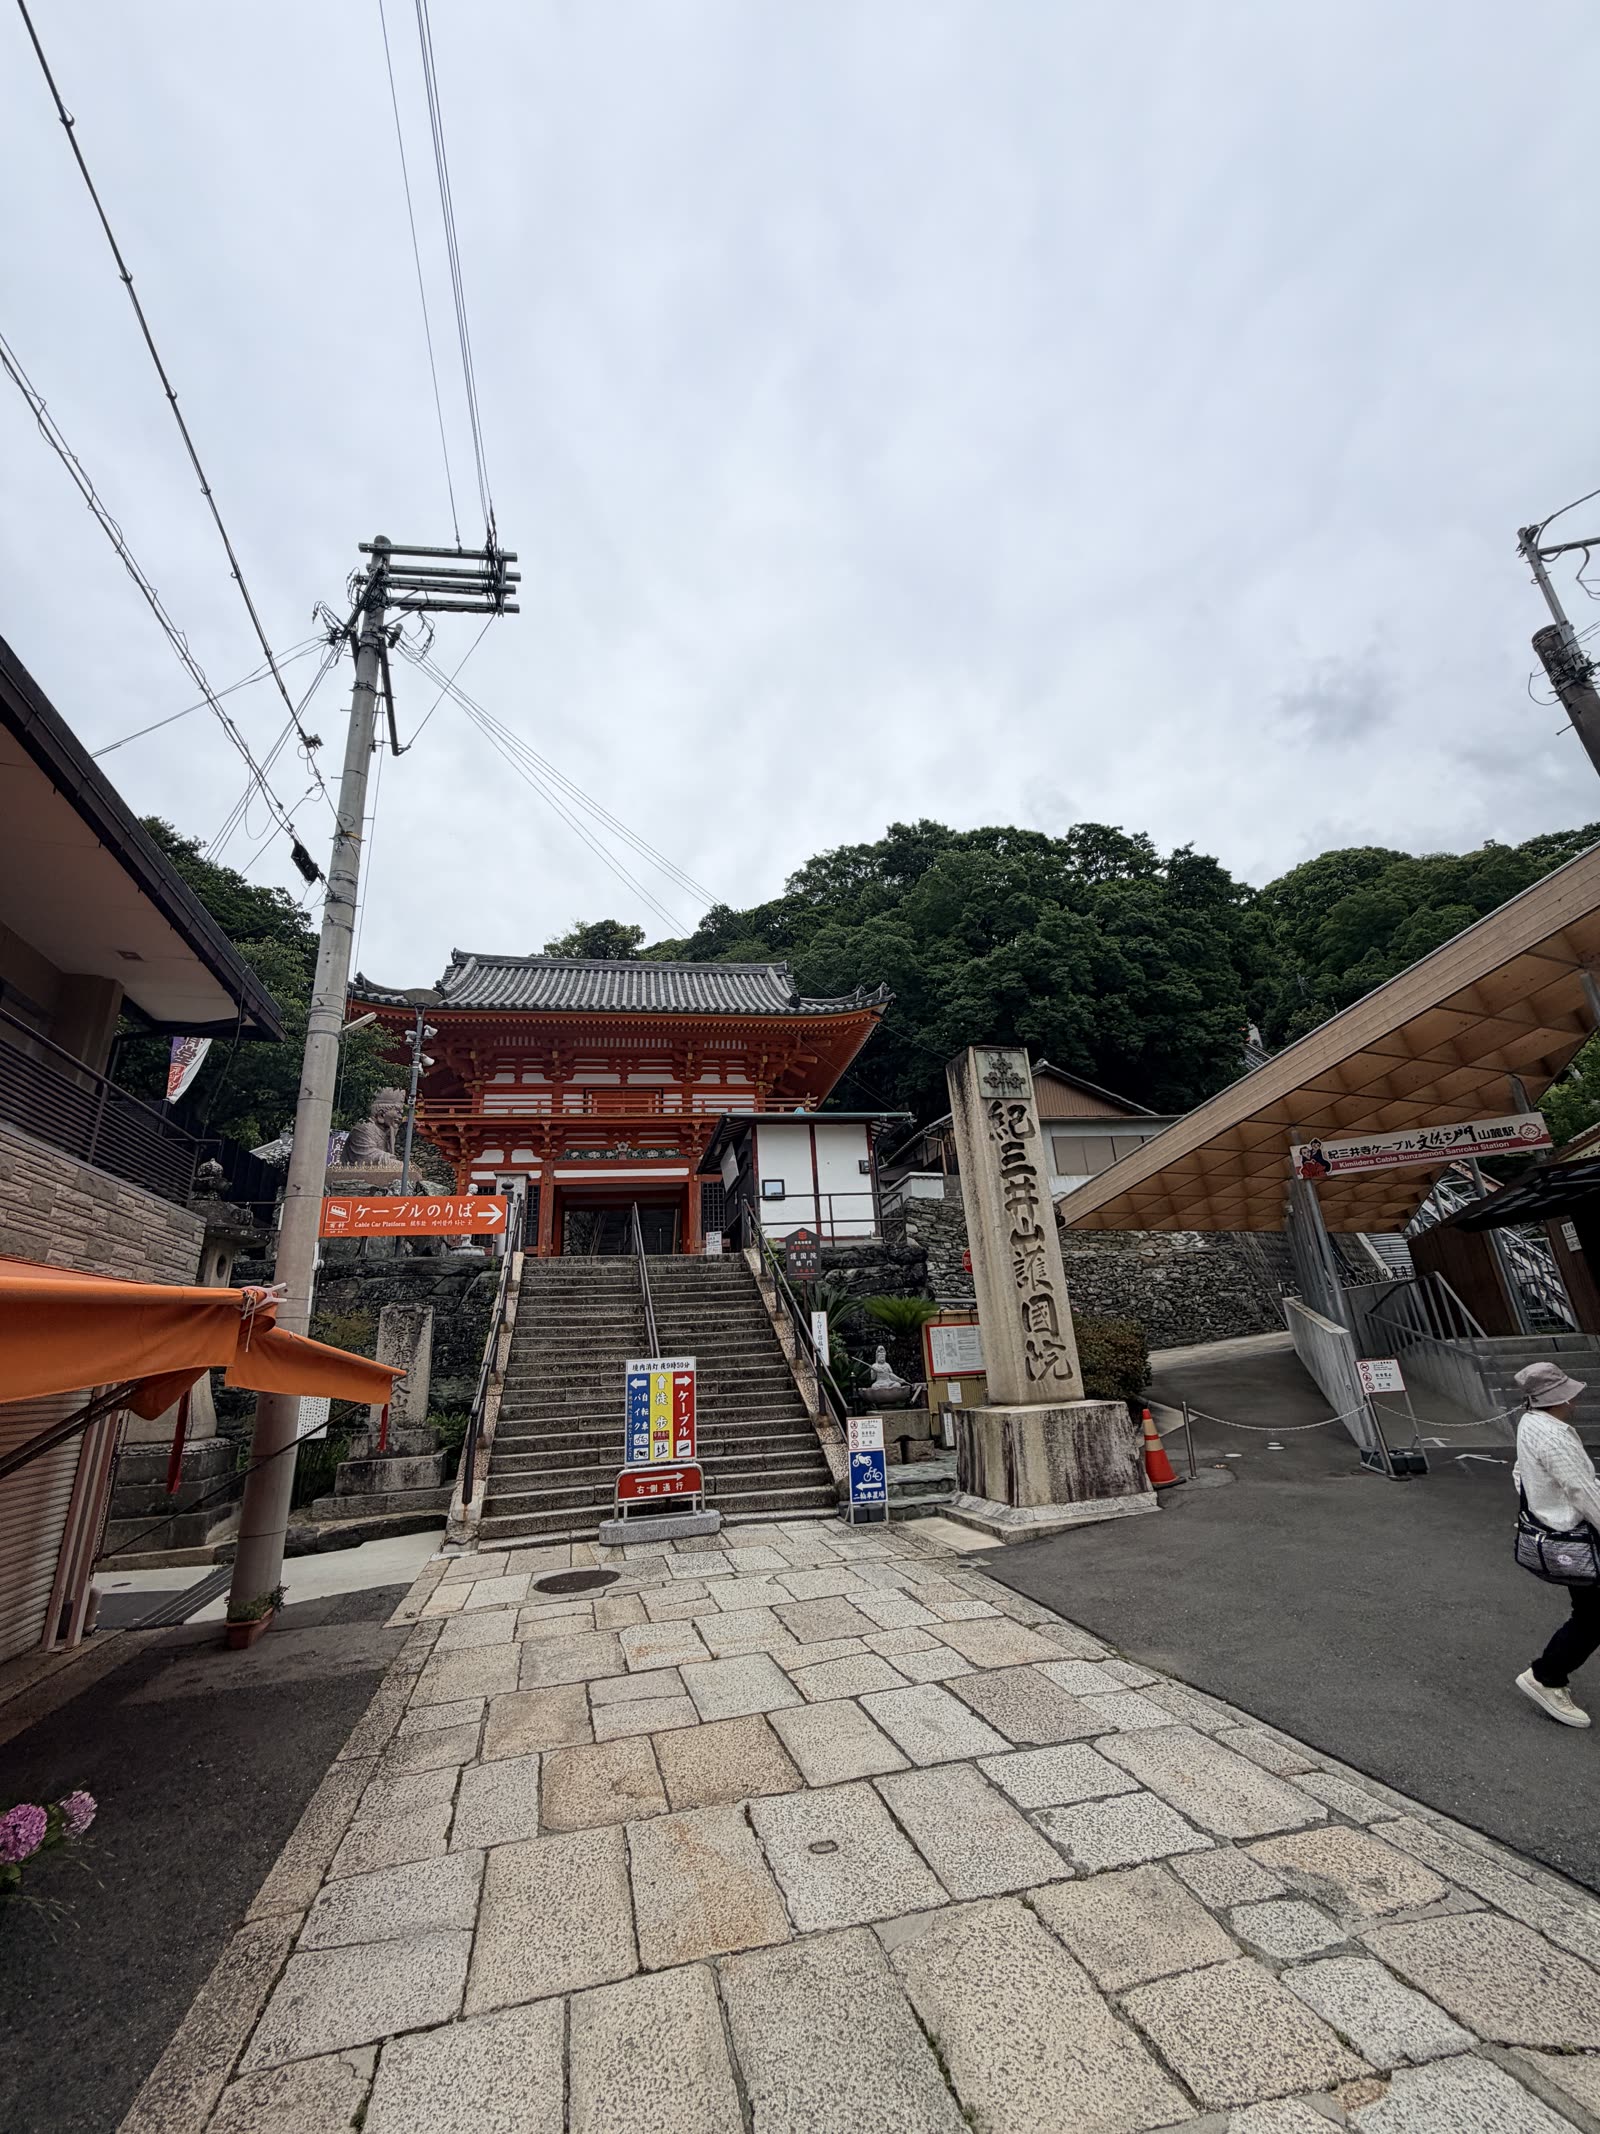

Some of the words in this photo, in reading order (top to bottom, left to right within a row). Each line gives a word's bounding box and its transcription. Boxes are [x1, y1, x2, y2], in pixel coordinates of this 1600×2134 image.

[1339, 1159, 1374, 1169] Kimiidera
[1376, 1156, 1397, 1164] Cable
[1399, 1150, 1444, 1161] Bunzaemon
[1446, 1145, 1479, 1155] Sanroku
[1480, 1141, 1510, 1151] Station
[355, 1201, 476, 1219] ケーブルのりば
[633, 1393, 641, 1430] バイク
[641, 1392, 649, 1430] 自転車
[655, 1391, 668, 1430] 徒歩
[678, 1390, 690, 1437] ケーブル
